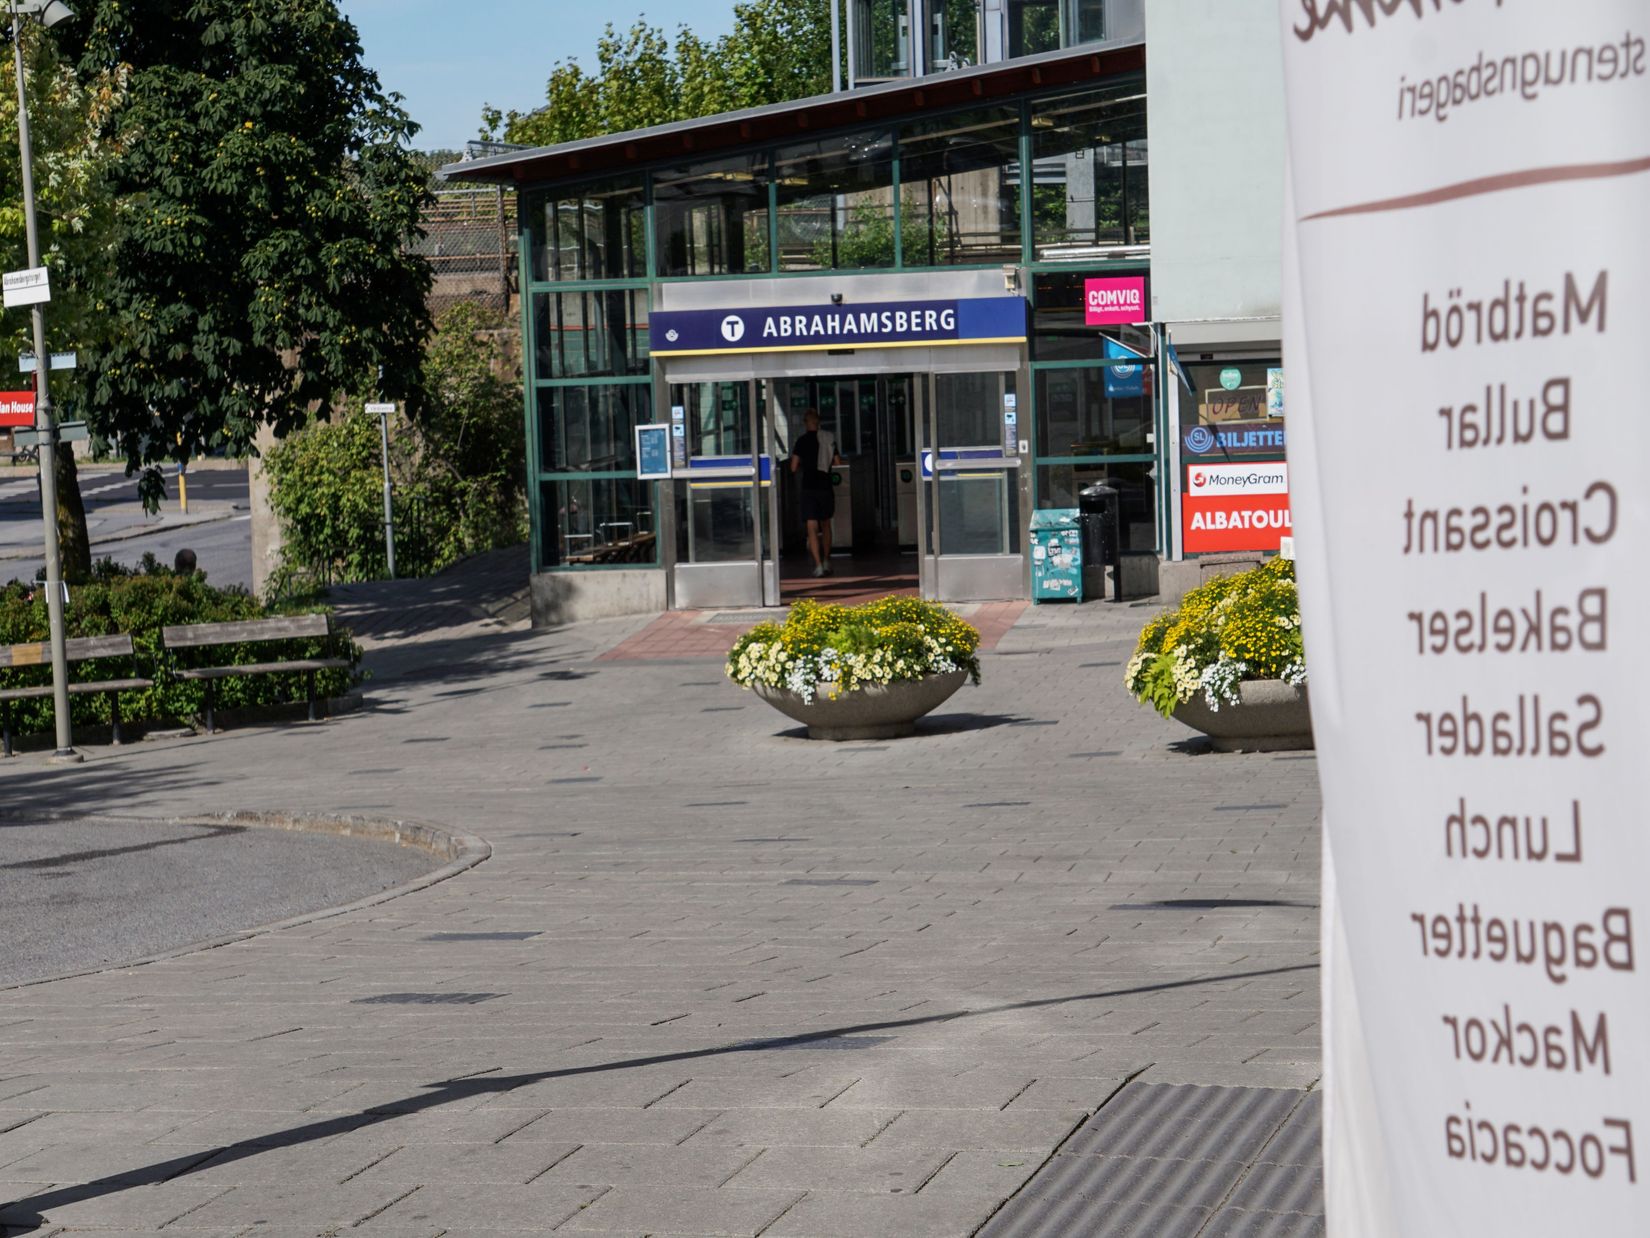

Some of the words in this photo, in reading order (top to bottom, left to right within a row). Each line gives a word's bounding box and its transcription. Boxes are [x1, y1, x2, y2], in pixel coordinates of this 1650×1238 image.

[1089, 289, 1140, 306] COMVIQ
[762, 309, 956, 338] ABRAHAMSBERG
[11, 401, 34, 414] House
[1212, 394, 1264, 415] OPEN
[1208, 473, 1284, 488] MoneyGram
[1190, 510, 1293, 530] ALBATOUL
